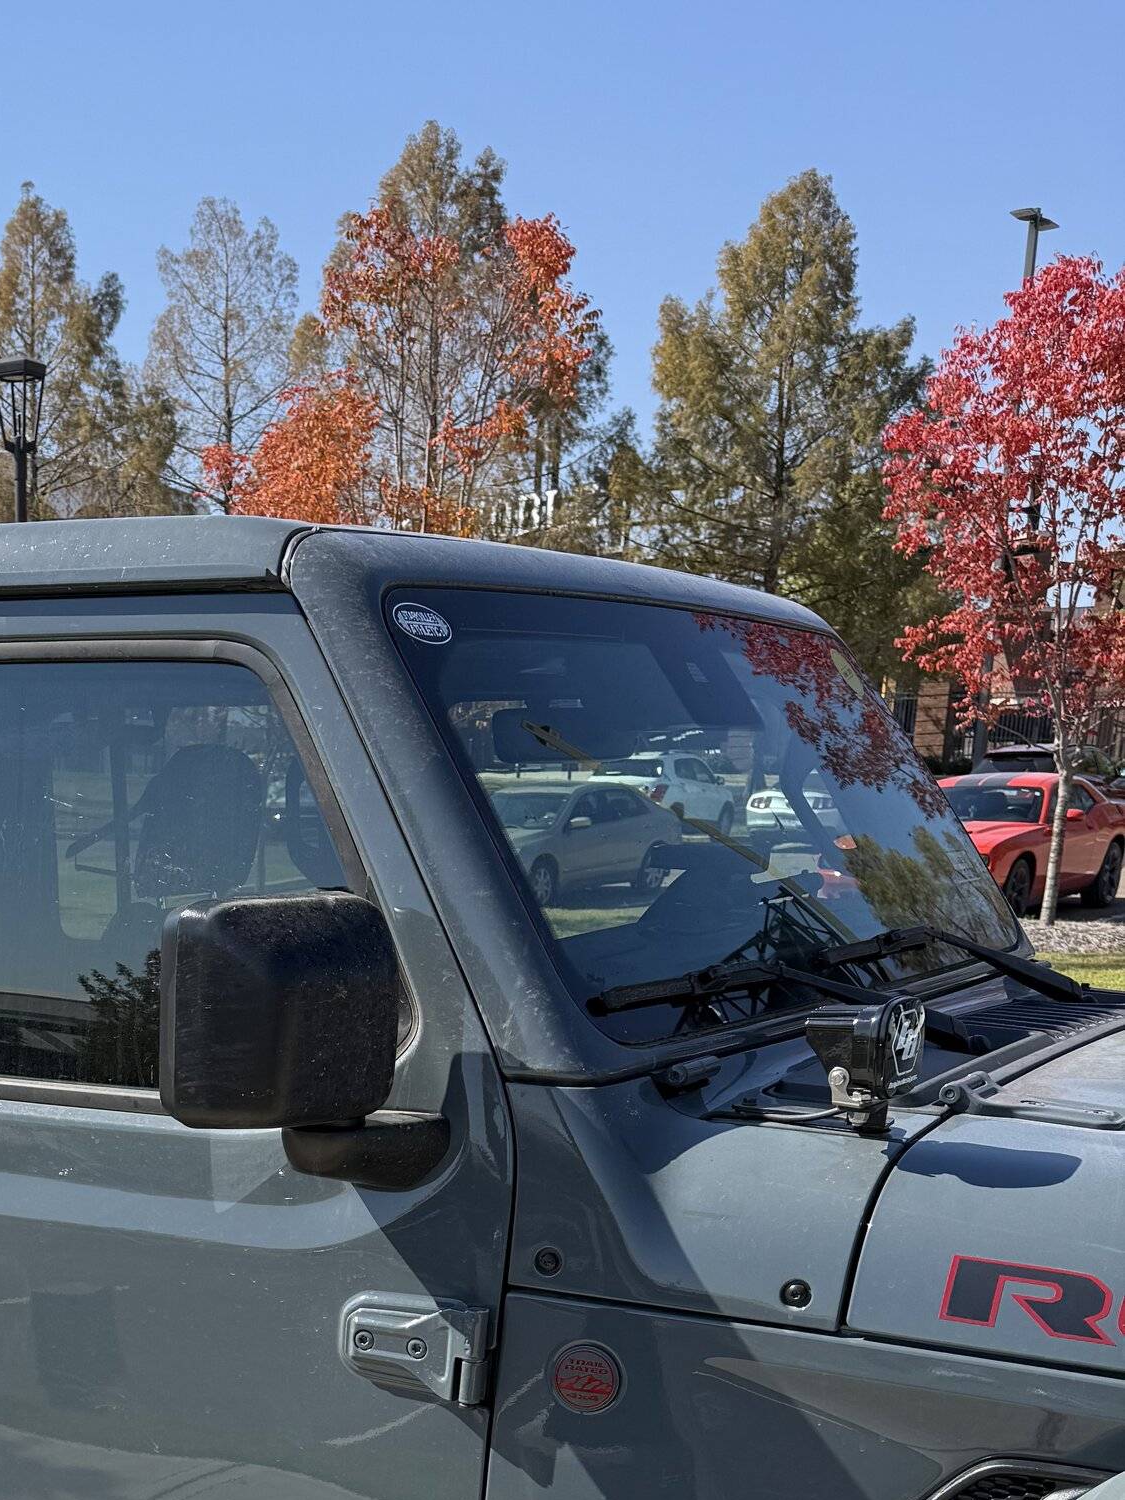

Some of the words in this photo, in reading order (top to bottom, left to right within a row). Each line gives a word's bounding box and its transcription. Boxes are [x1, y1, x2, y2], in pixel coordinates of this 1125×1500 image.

[938, 1255, 1125, 1347] R
[569, 1359, 605, 1368] TRAIL
[564, 1365, 608, 1375] RATED
